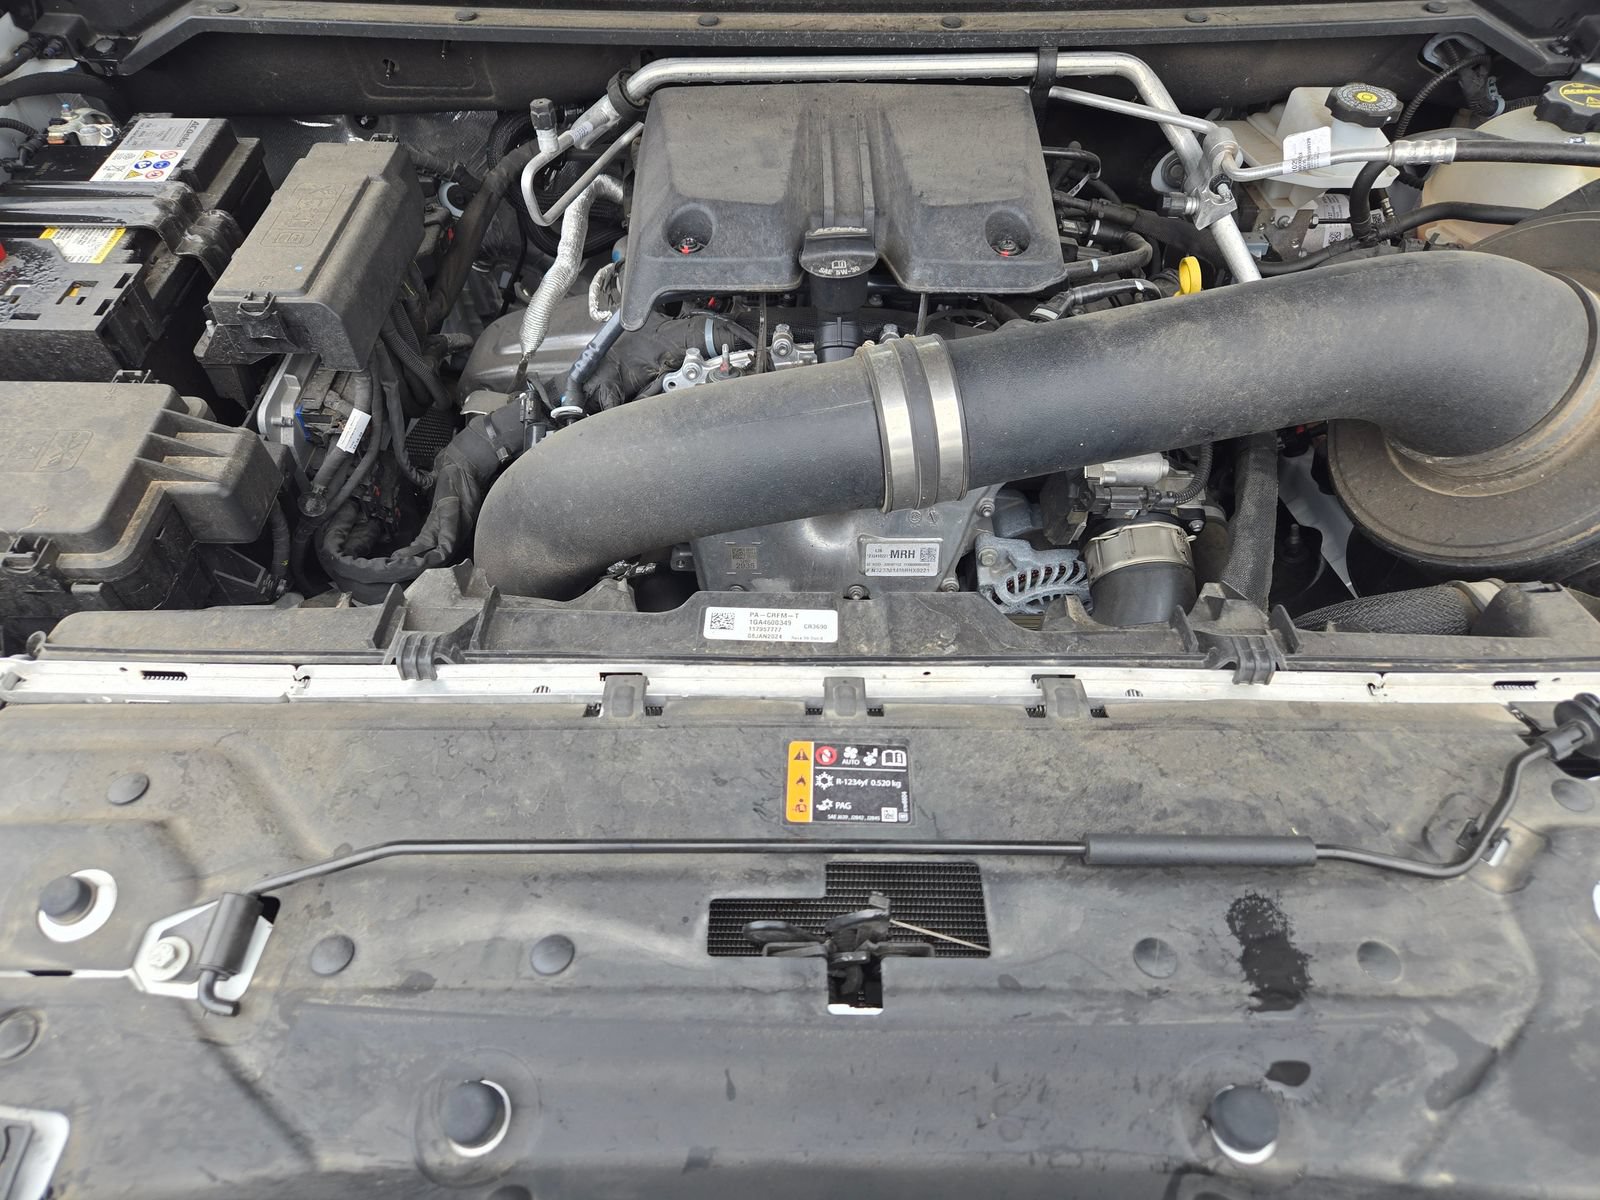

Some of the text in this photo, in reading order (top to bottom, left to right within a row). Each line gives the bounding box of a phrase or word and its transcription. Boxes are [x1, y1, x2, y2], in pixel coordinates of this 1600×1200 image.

[890, 549, 916, 559] MRH
[841, 758, 860, 766] AUTO
[835, 778, 902, 788] R-1234yf 0.520 kg
[835, 802, 852, 810] PAG
